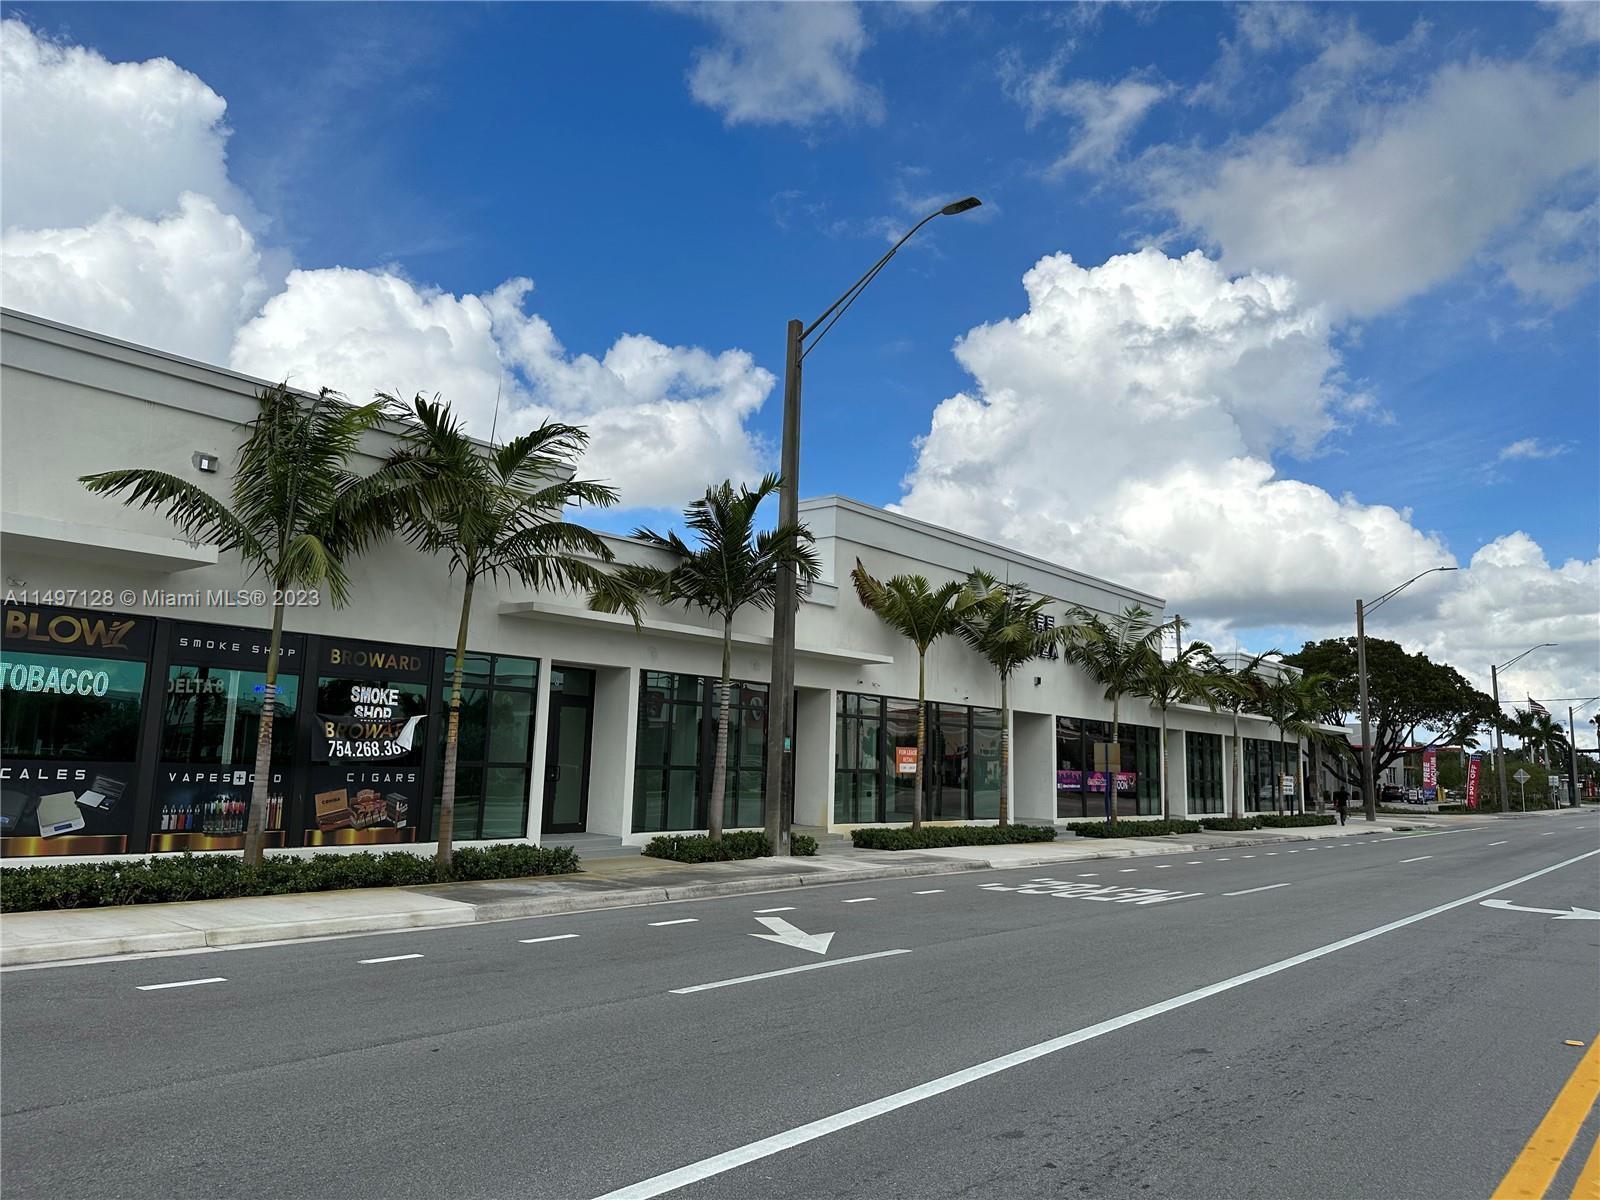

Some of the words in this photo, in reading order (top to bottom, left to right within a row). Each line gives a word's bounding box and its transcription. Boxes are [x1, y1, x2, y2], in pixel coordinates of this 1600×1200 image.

[179, 637, 241, 652] SMOKE
[330, 648, 422, 671] BROWARD
[0, 662, 109, 697] TOBACCO
[350, 685, 400, 706] SMOKE
[353, 705, 393, 719] SHOP
[328, 739, 407, 757] 754.268.36
[169, 772, 232, 783] VAPES
[248, 774, 282, 783] CD
[346, 773, 416, 783] CIGARS
